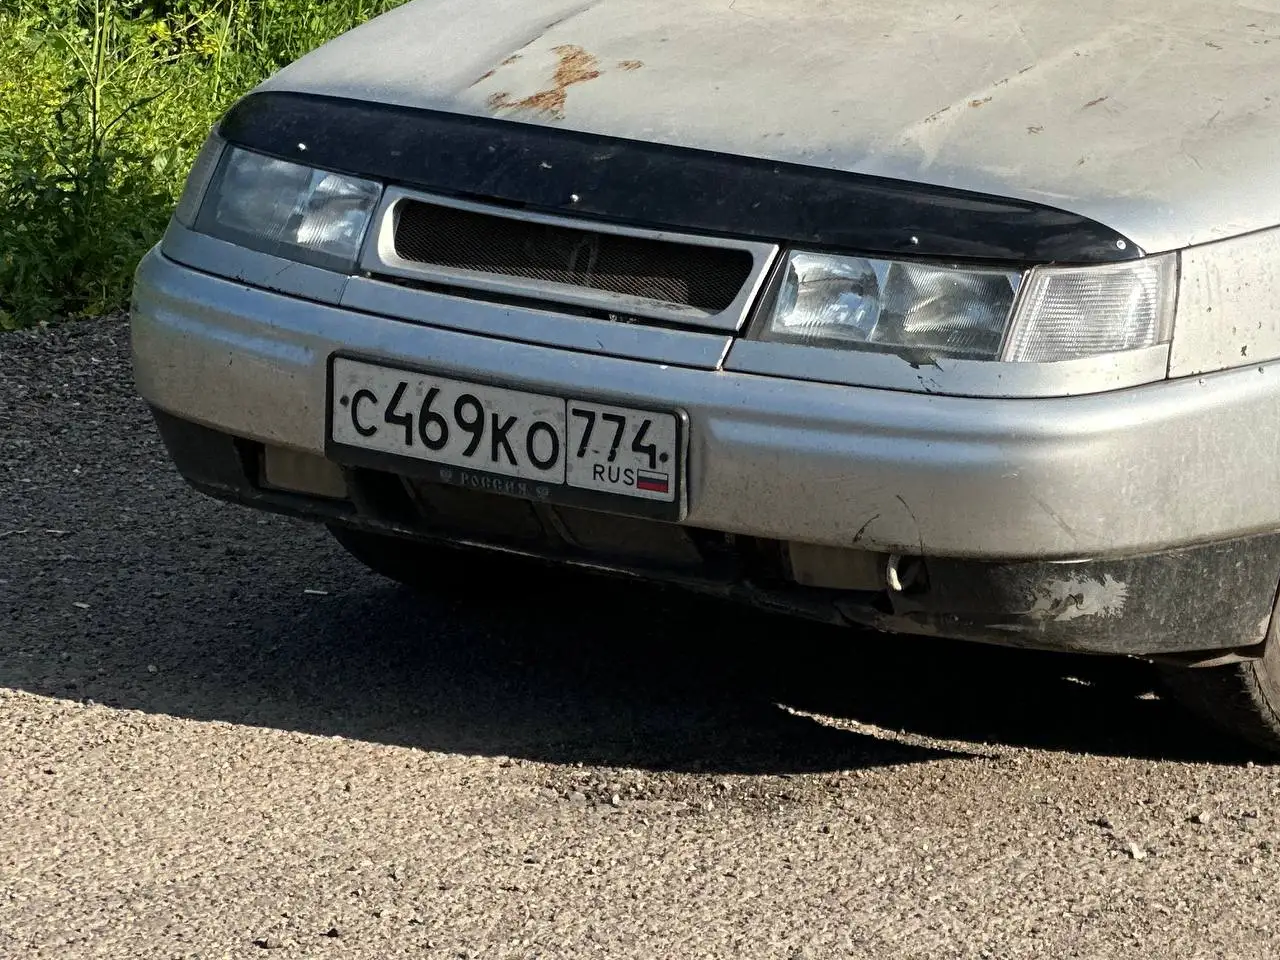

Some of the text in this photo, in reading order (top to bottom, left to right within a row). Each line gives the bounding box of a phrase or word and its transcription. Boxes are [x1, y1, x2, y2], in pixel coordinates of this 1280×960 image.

[572, 408, 657, 469] 774
[460, 471, 529, 495] РОССИЯ
[593, 463, 635, 487] RUS
